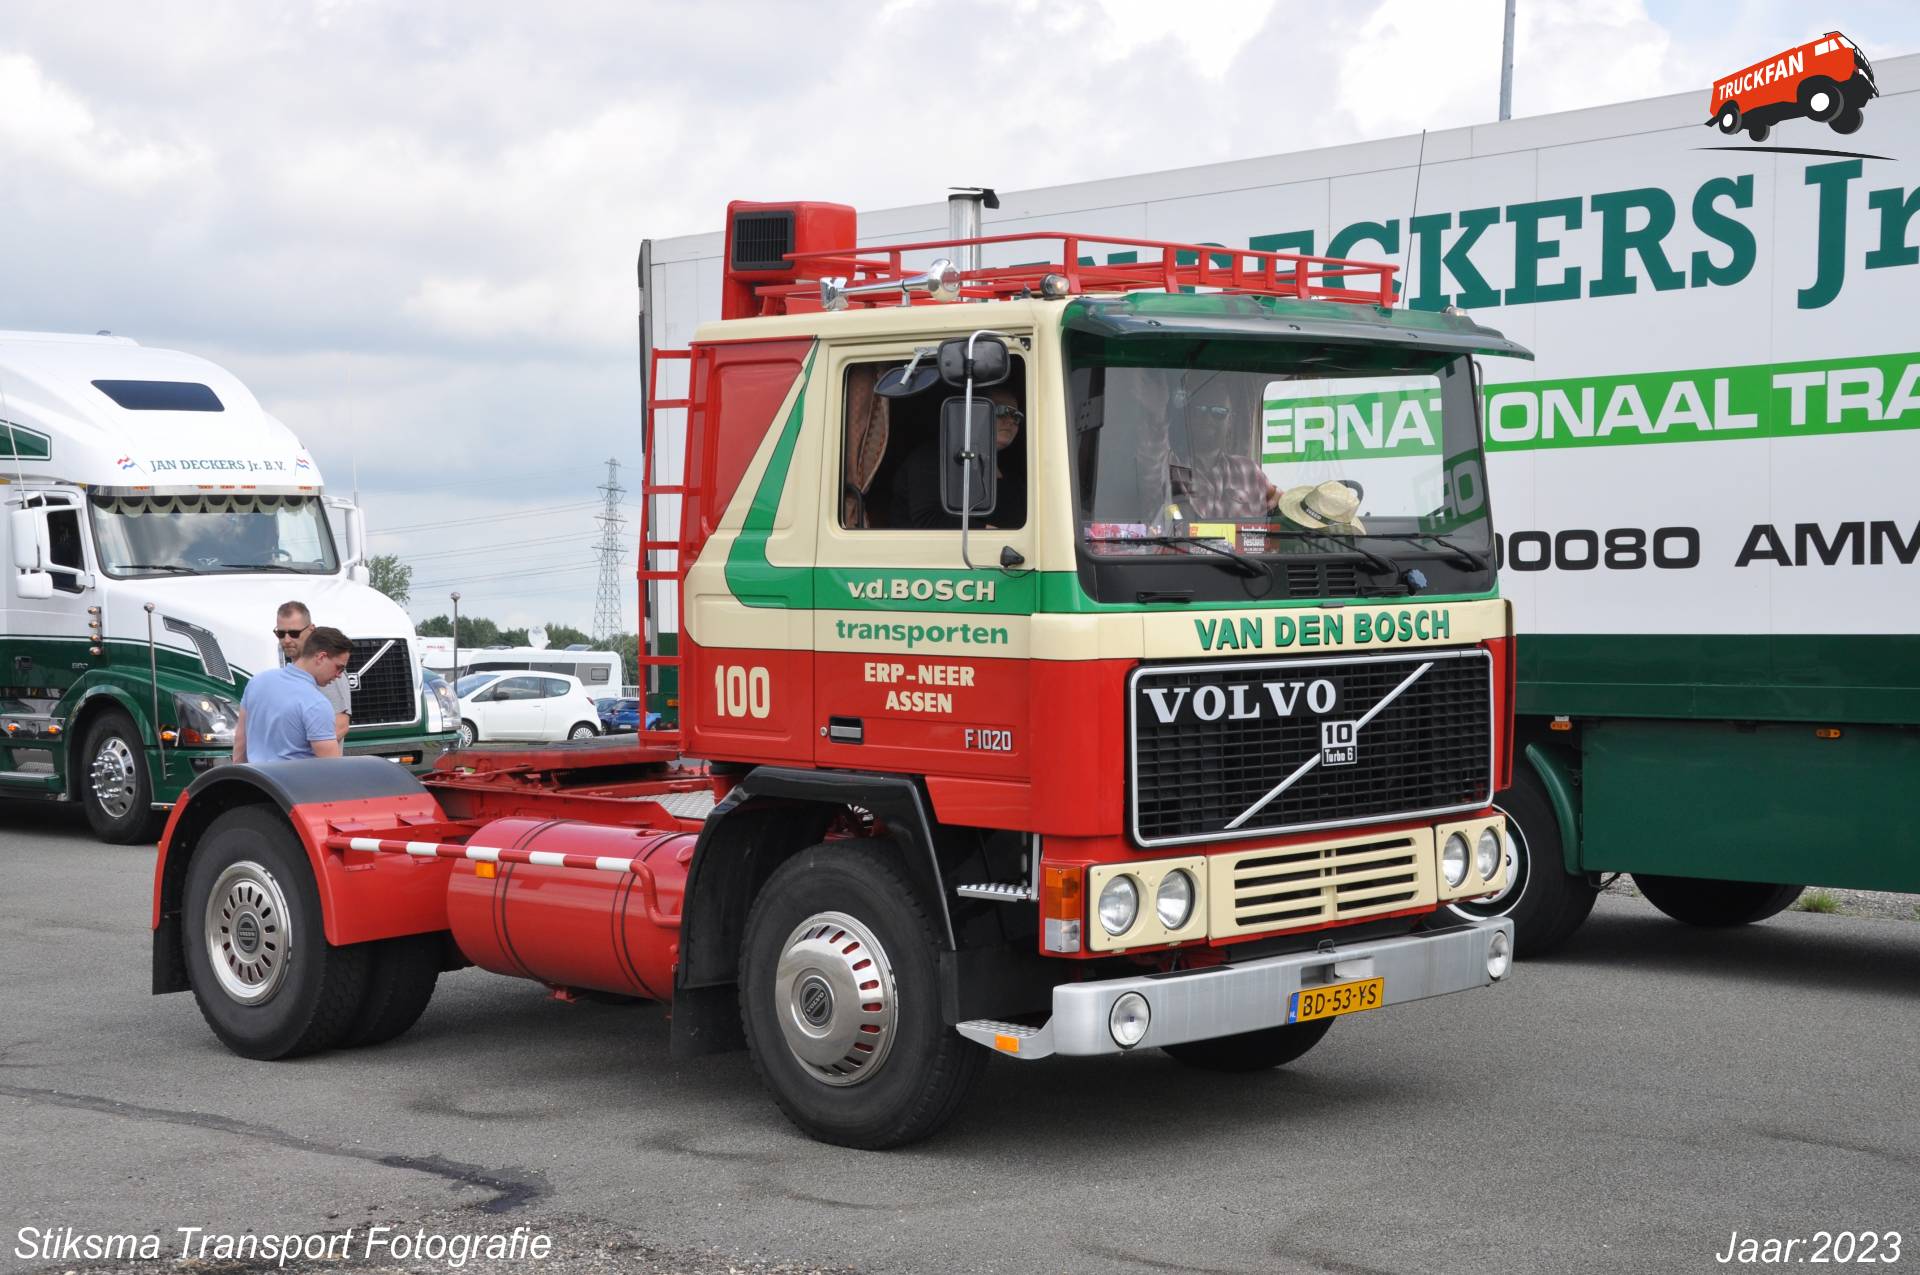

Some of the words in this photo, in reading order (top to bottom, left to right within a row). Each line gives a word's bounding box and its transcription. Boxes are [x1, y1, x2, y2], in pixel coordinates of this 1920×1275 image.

[150, 460, 176, 472] JAN
[181, 460, 245, 470] DECKERS
[264, 461, 286, 471] B.V.
[1495, 526, 1700, 571] 0080
[848, 578, 996, 602] v.d.BOSCH
[836, 619, 1008, 648] transporten
[1194, 617, 1263, 651] VAN
[1274, 613, 1343, 647] DEN
[1353, 609, 1450, 643] BOSCH
[714, 664, 770, 718] 100
[885, 690, 953, 713] ASSEN
[1142, 679, 1337, 724] VOLVO
[1326, 723, 1353, 745] 10
[1324, 748, 1346, 762] Turbo
[1347, 747, 1353, 761] 6
[805, 991, 825, 1013] VOLVO
[1303, 983, 1377, 1017] BD-53-YS
